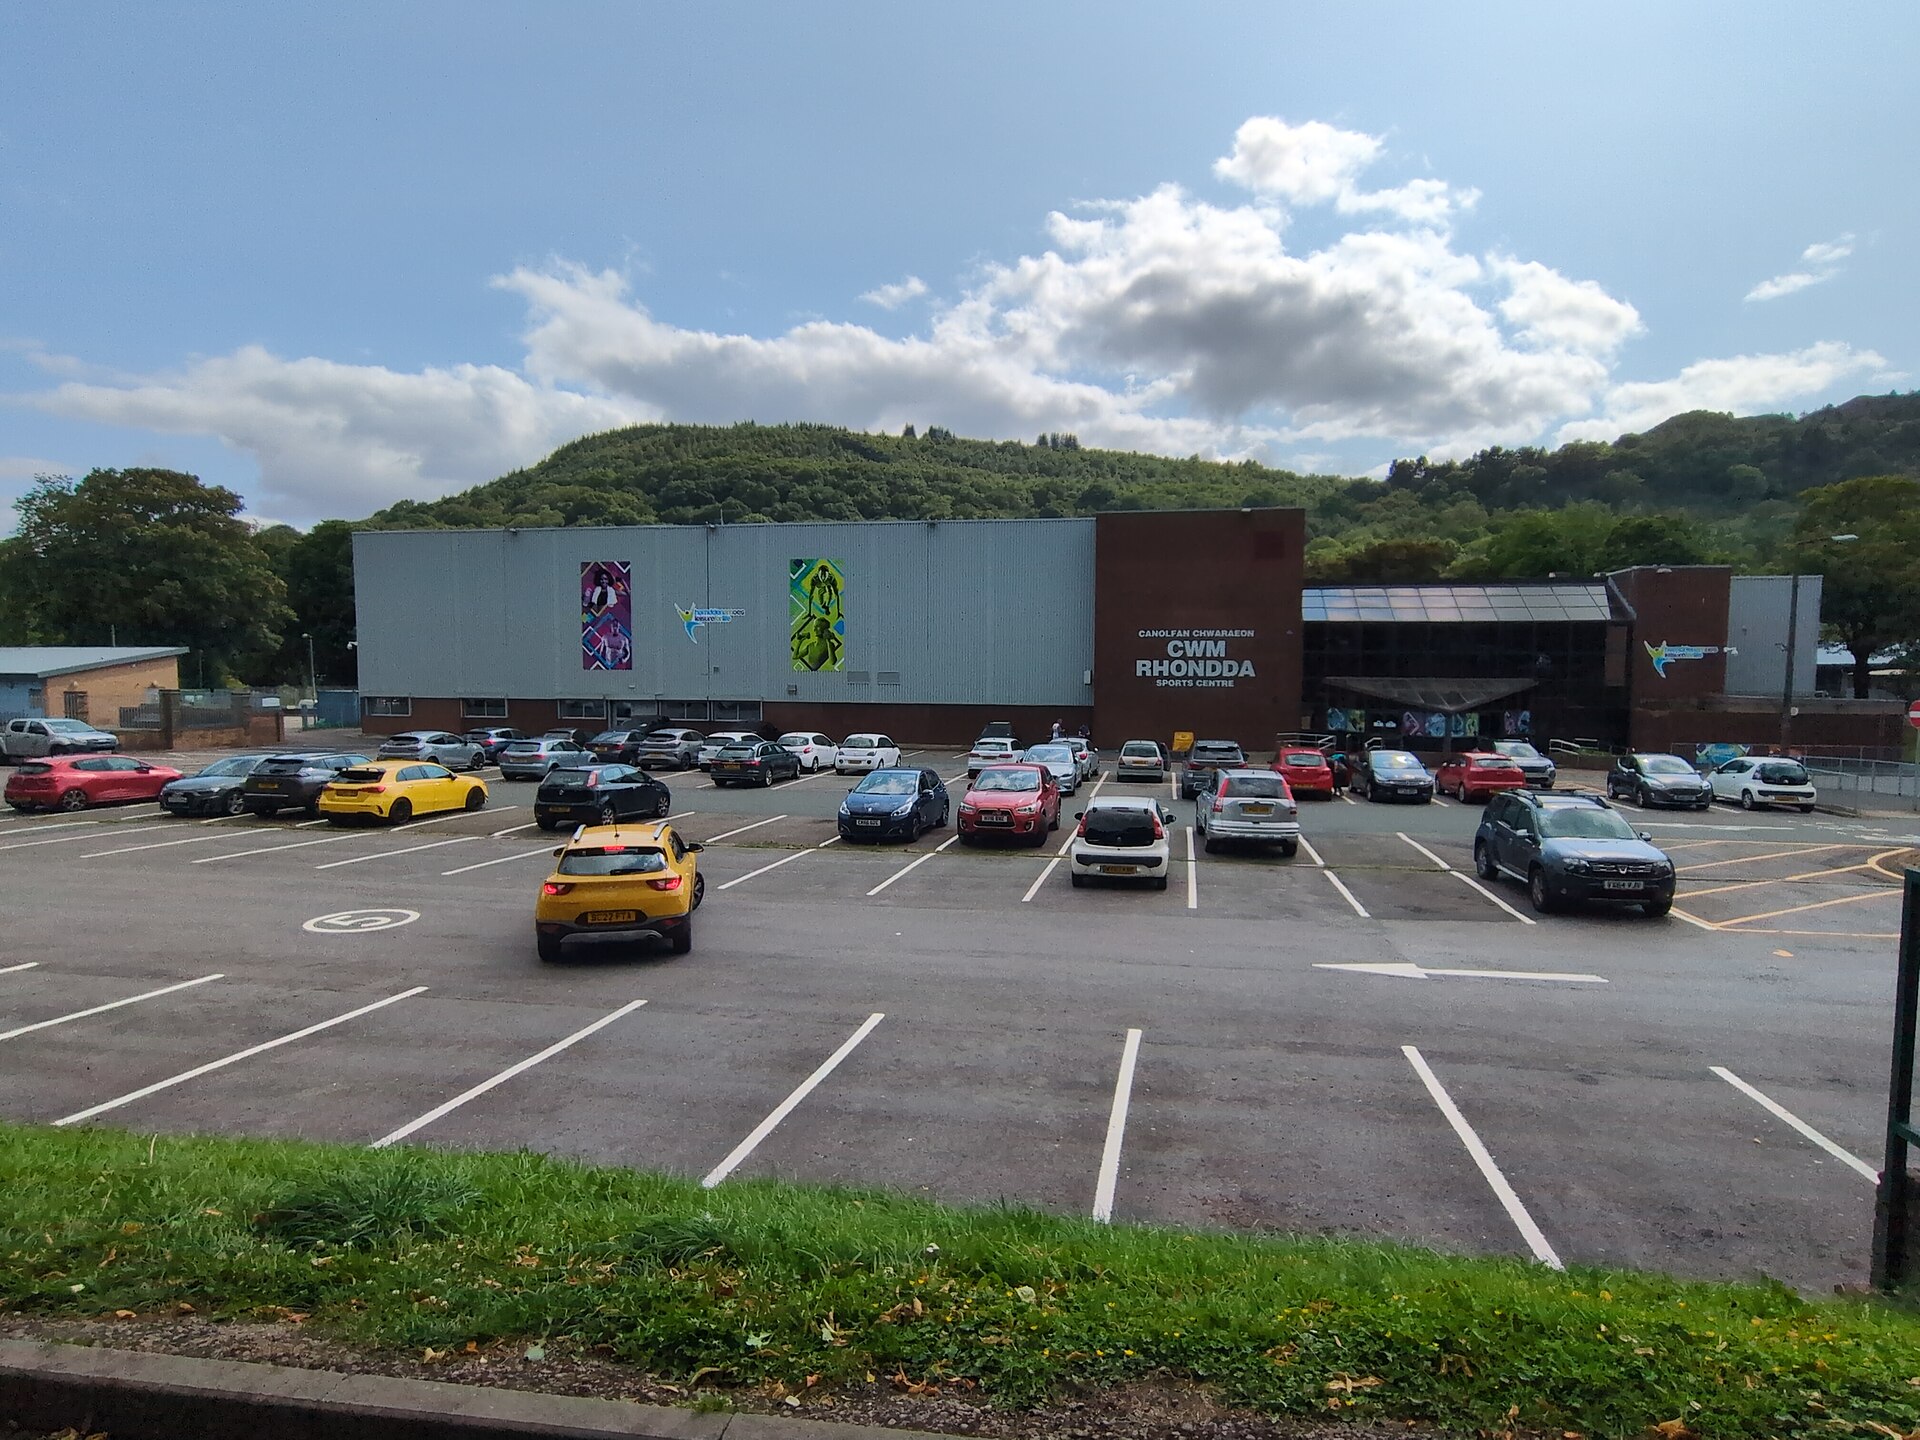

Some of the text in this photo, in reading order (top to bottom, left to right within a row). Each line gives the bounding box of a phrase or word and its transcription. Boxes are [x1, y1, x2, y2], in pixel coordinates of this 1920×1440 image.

[1138, 629, 1255, 638] CANOLFAN CHWARAEON
[1167, 640, 1226, 658] CWM
[1136, 660, 1256, 677] RHONDDA
[1196, 680, 1235, 688] CENTRE
